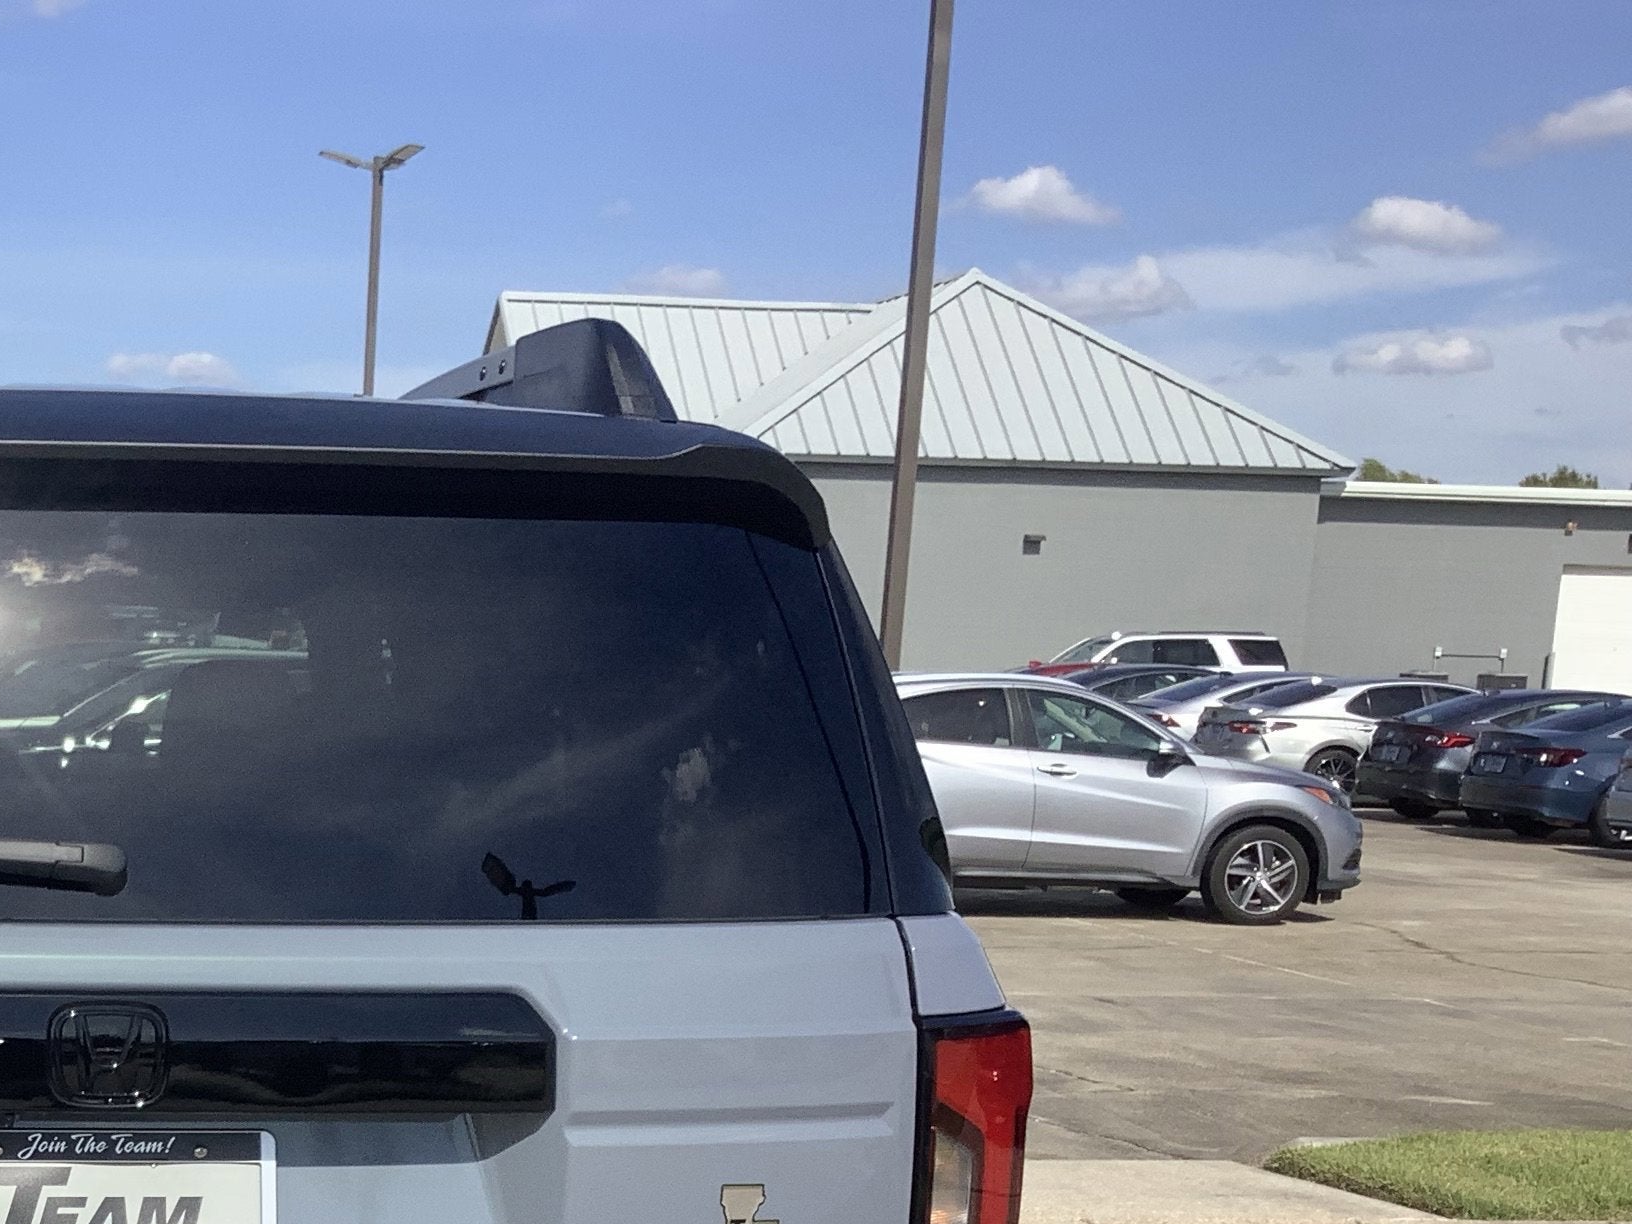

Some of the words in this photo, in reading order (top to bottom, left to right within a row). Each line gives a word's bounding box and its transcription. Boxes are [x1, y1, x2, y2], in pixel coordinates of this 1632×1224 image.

[17, 1133, 68, 1160] Join
[70, 1133, 108, 1154] The
[111, 1133, 176, 1154] Team!
